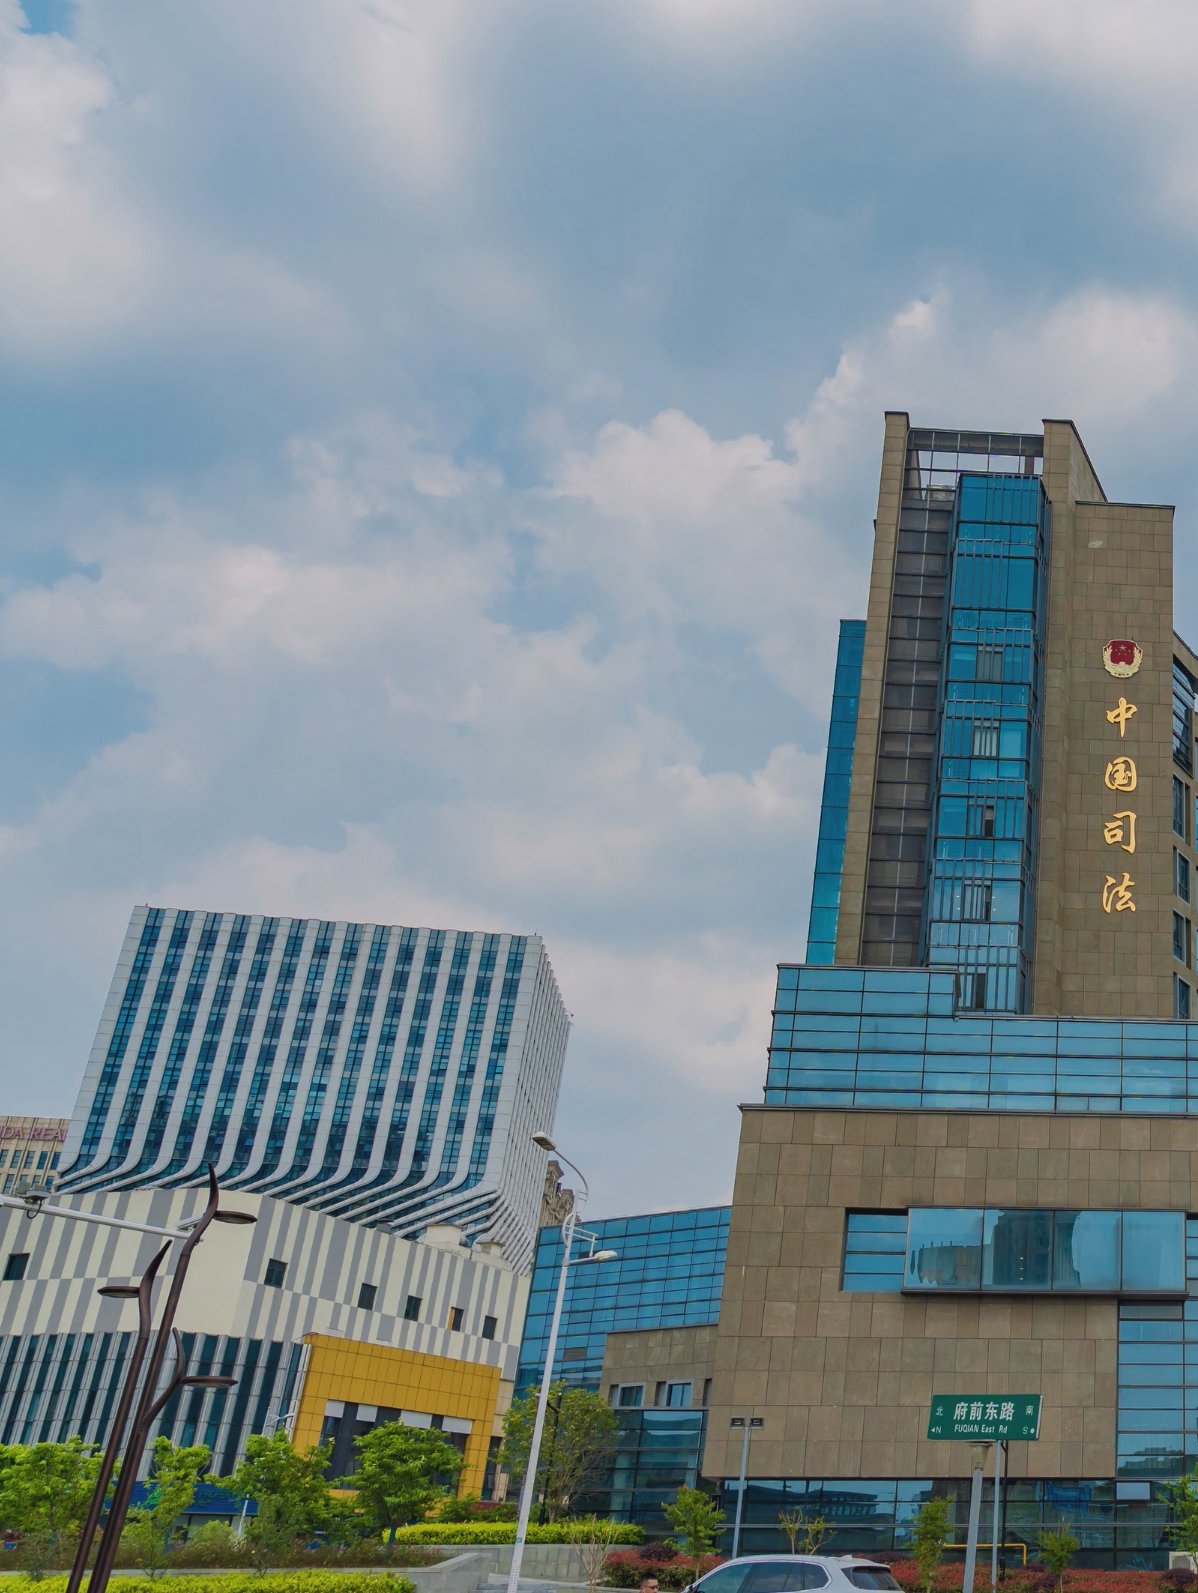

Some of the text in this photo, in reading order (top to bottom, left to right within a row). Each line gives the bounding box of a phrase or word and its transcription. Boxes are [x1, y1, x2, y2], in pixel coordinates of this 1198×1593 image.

[1103, 697, 1138, 914] 中国司法
[0, 1125, 24, 1140] DA
[935, 1401, 1034, 1421] 北 府前东路 南
[936, 1426, 942, 1434] N
[954, 1424, 980, 1433] FUQIAN
[981, 1424, 995, 1433] East
[999, 1425, 1008, 1434] Rd
